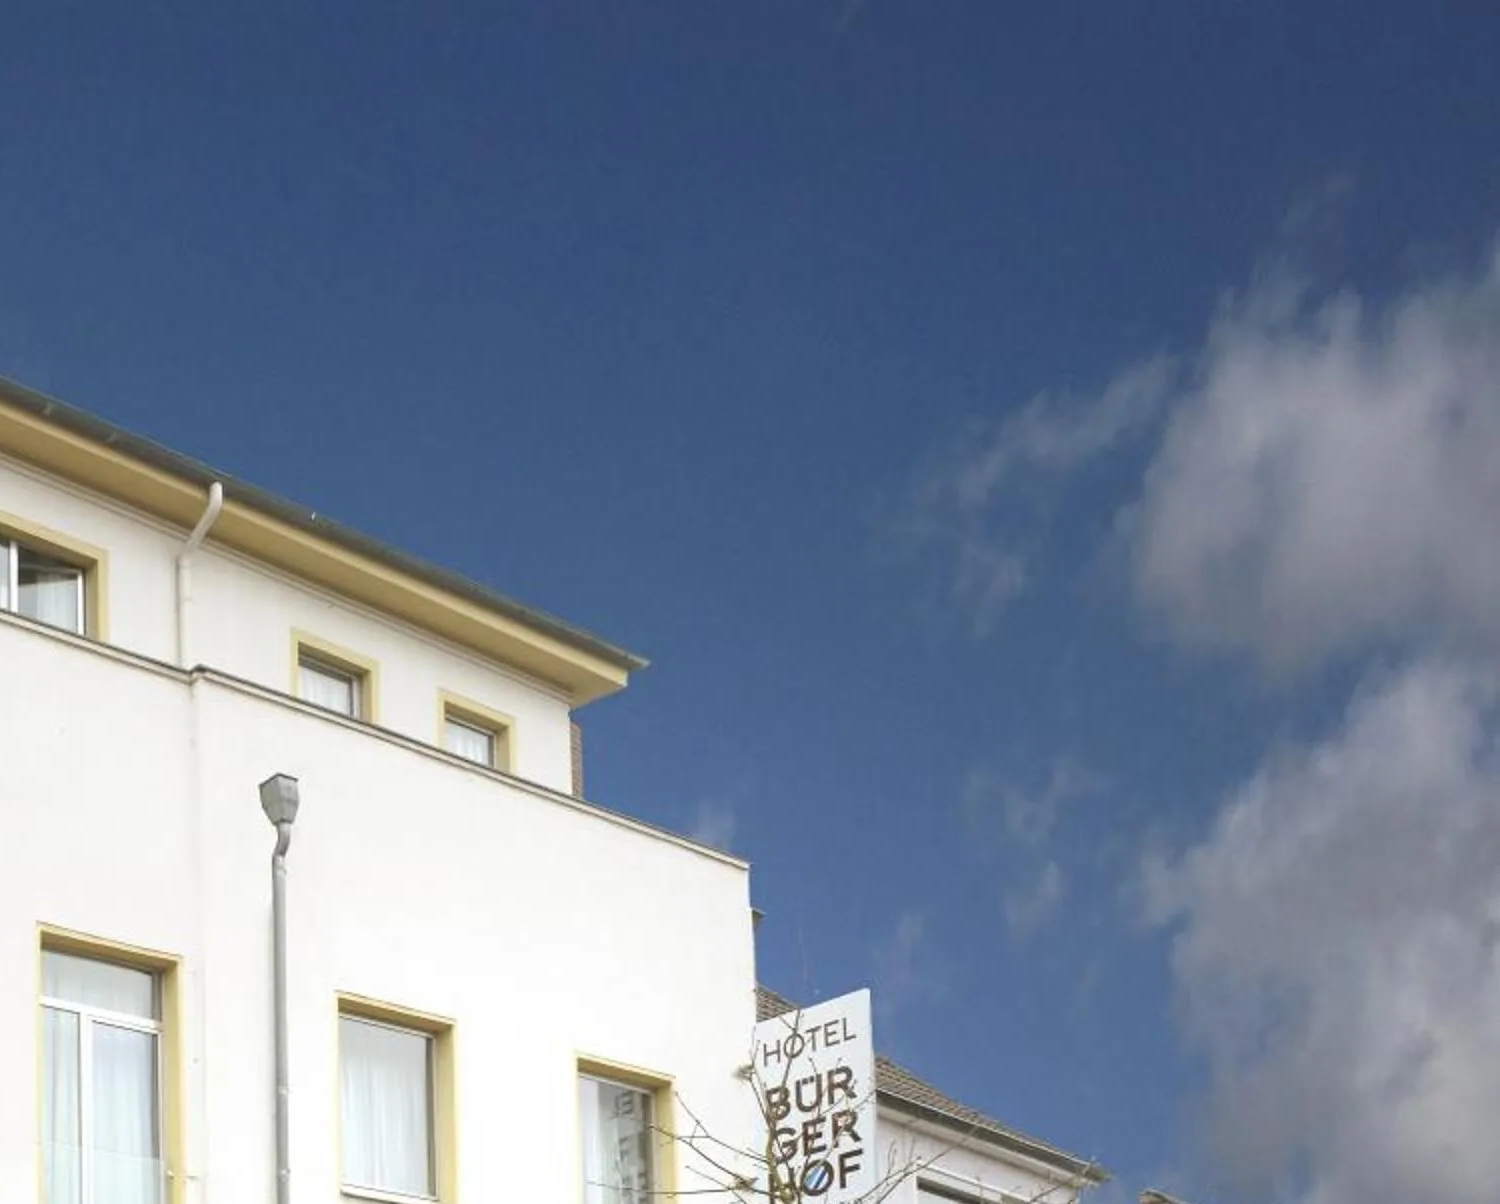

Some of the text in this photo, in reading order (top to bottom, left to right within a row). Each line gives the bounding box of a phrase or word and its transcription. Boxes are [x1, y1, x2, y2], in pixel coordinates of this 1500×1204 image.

[763, 1017, 857, 1067] HOTEL
[765, 1065, 858, 1121] BÜR
[771, 1109, 863, 1165] GER
